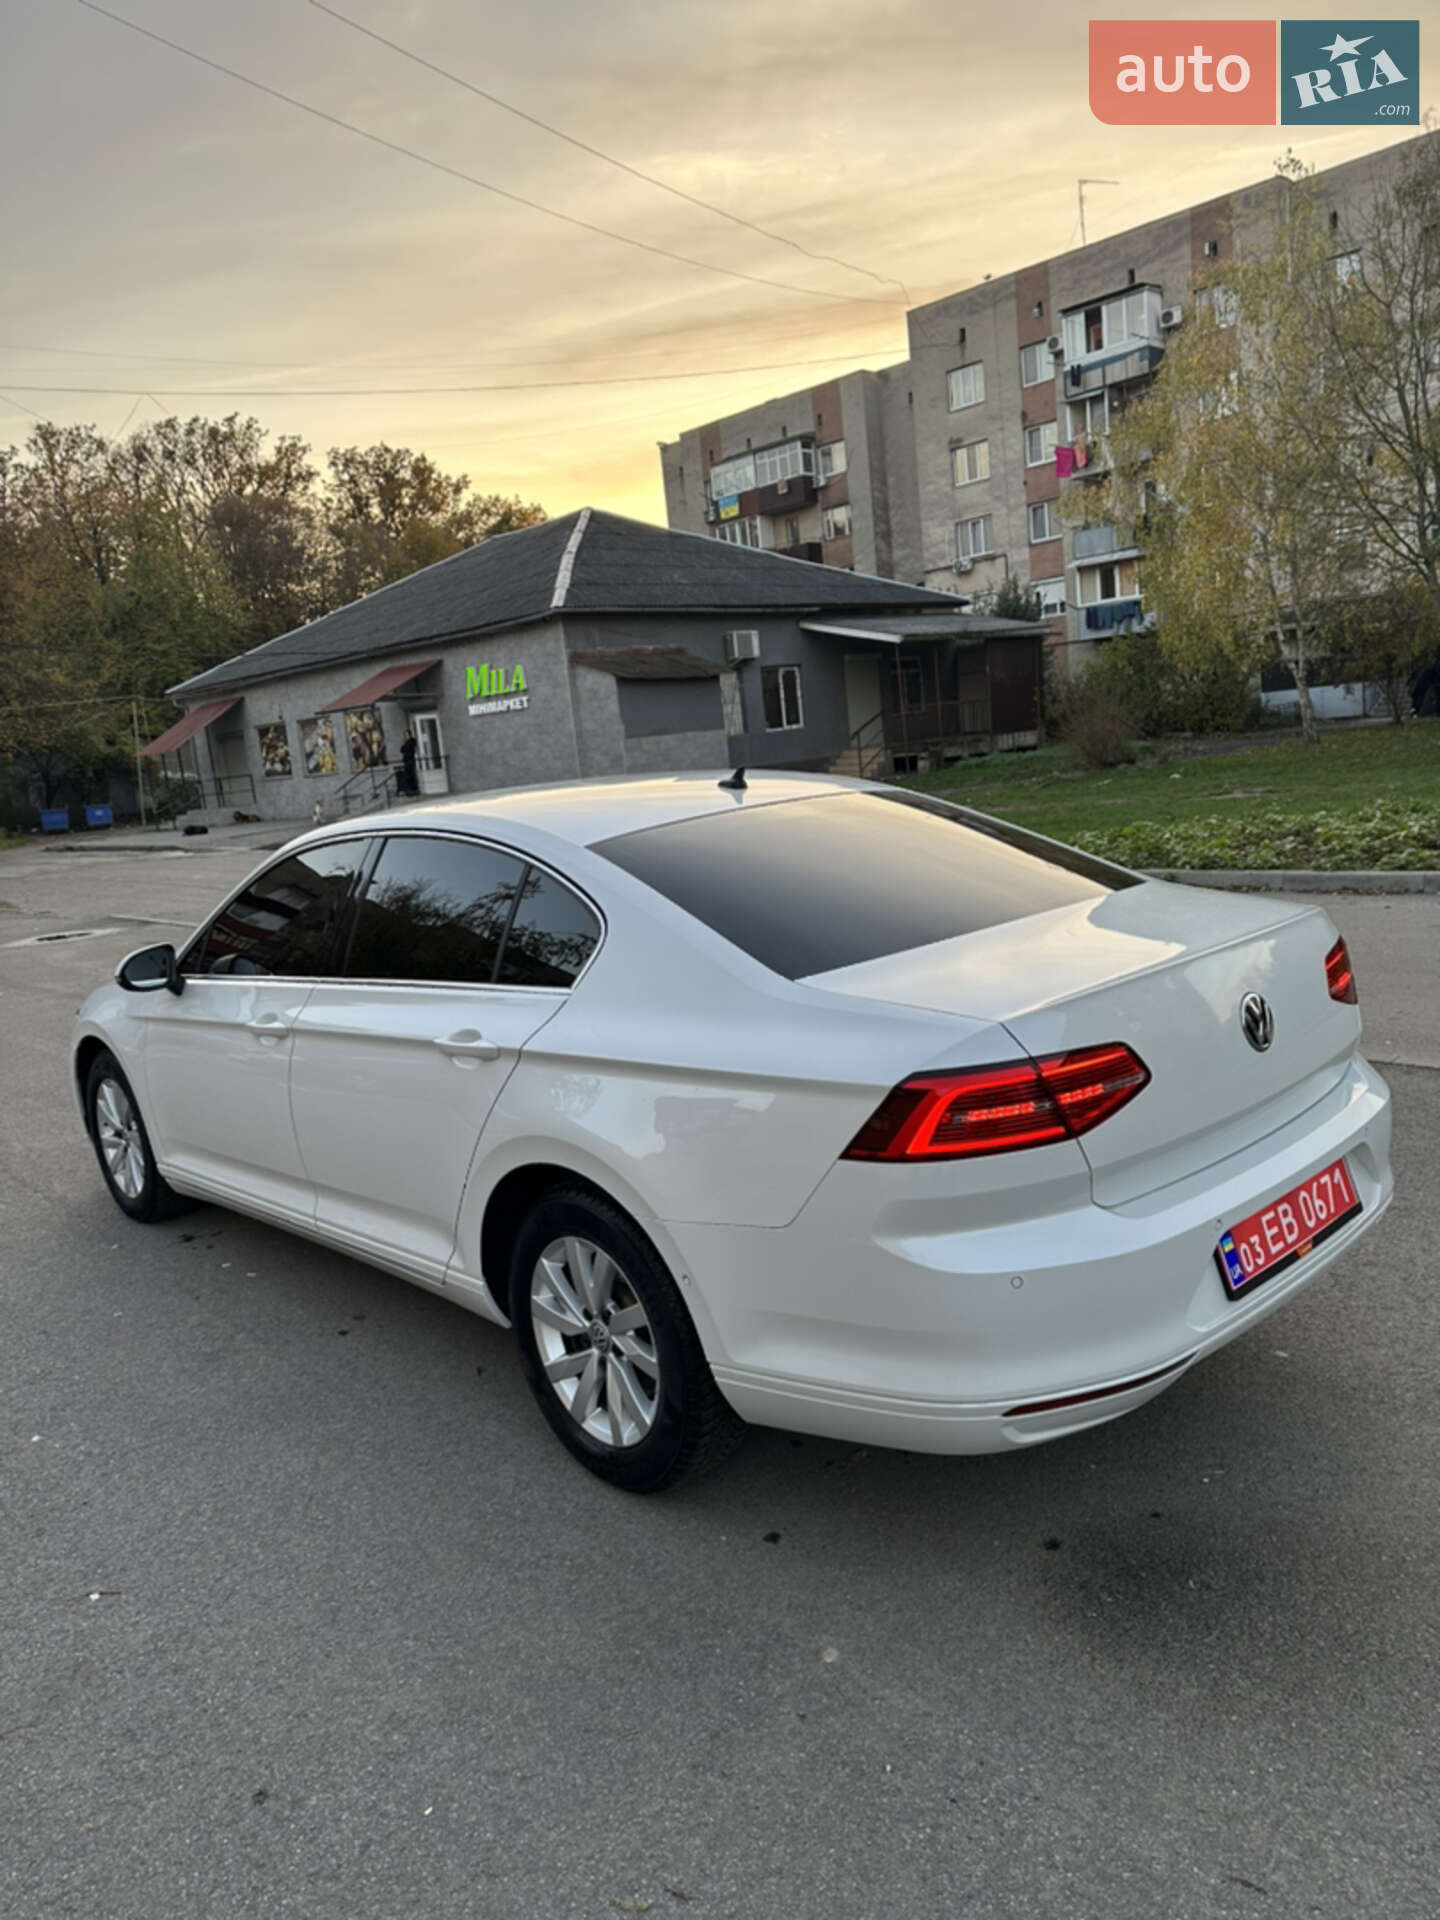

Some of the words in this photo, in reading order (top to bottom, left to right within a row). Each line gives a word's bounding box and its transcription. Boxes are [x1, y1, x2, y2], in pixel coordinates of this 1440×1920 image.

[1240, 1235, 1266, 1273] 03
[1261, 1202, 1299, 1255] EB
[1298, 1167, 1350, 1228] 0671
